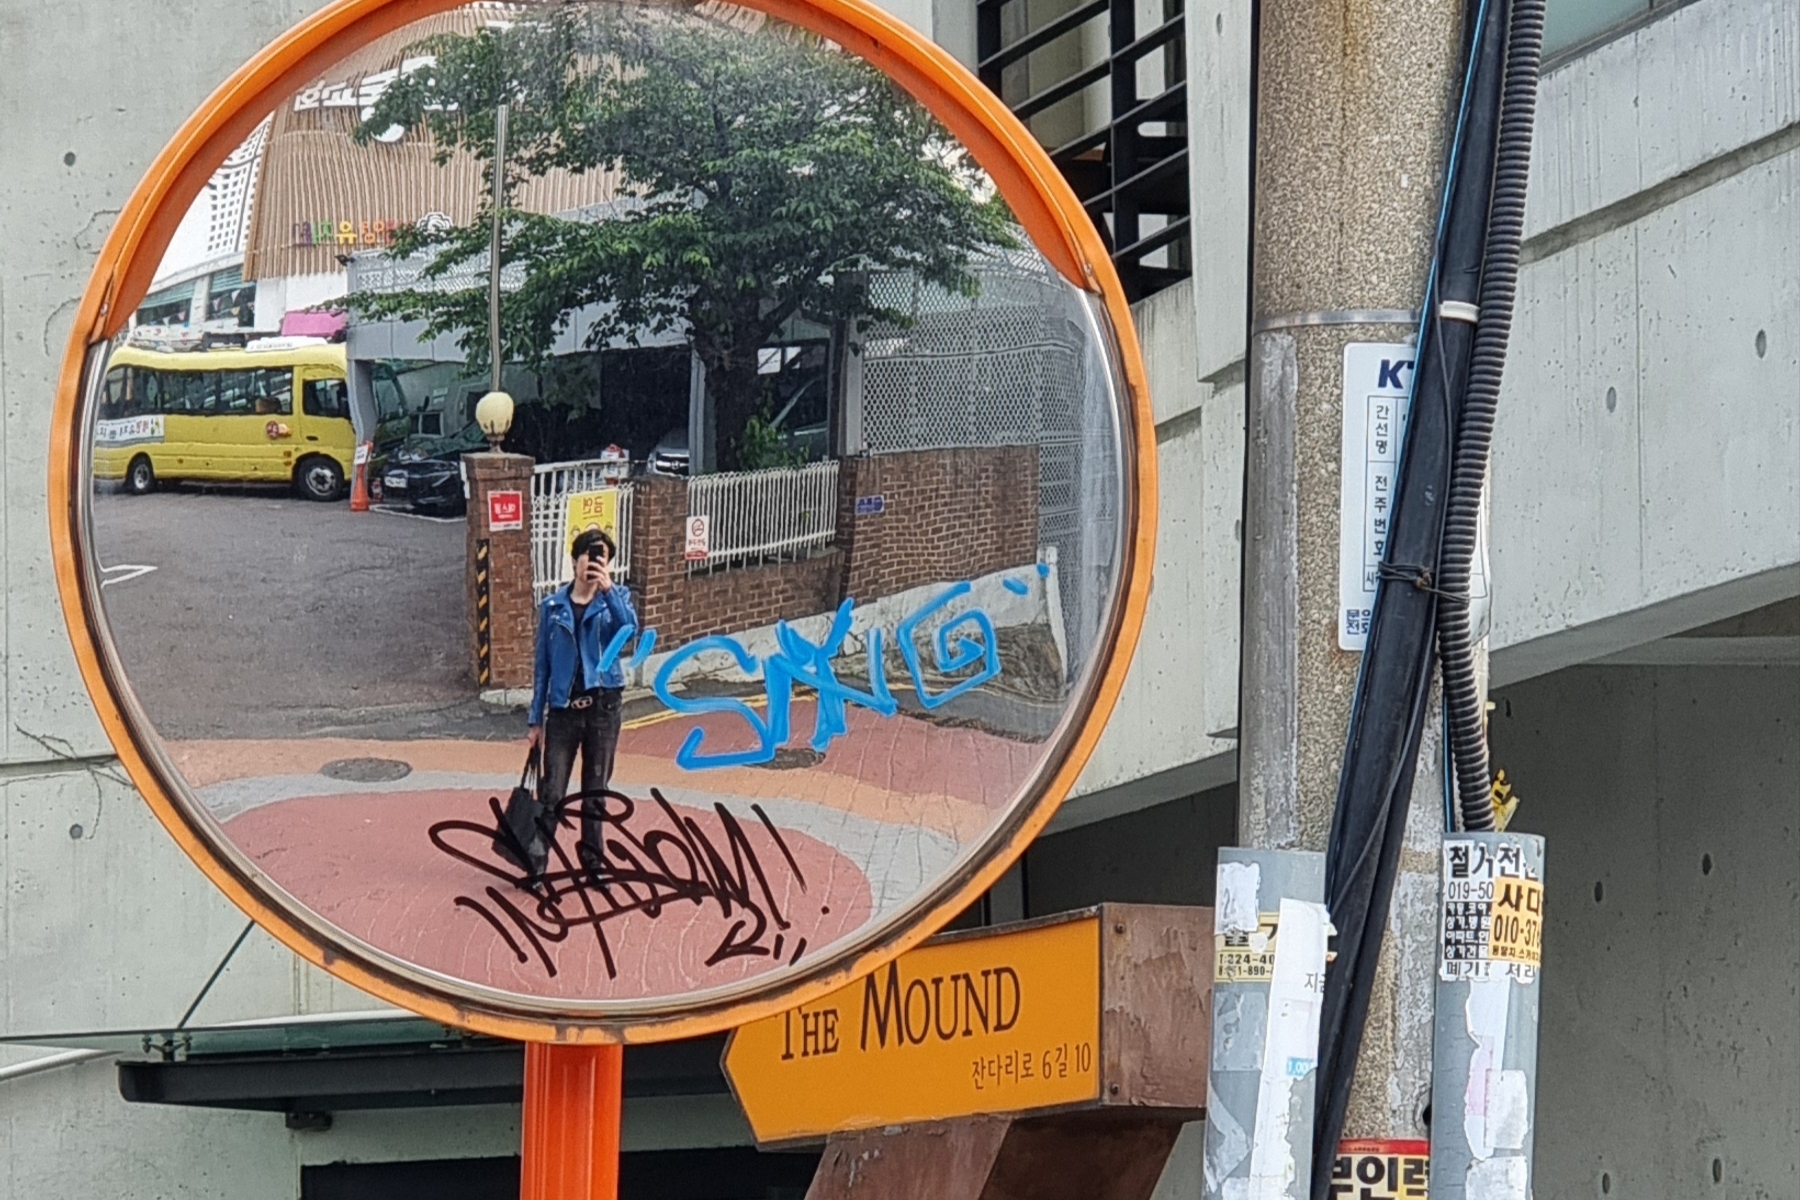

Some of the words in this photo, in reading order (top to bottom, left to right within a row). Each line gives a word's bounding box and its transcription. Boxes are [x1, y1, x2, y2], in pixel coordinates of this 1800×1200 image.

[1375, 405, 1389, 455] 간선명
[1373, 475, 1388, 556] 전주번호
[781, 1007, 840, 1060] THE
[860, 960, 1021, 1051] MOUND
[972, 1050, 1034, 1090] 잔다리로
[1042, 1043, 1068, 1080] 6길
[1075, 1042, 1091, 1073] 10
